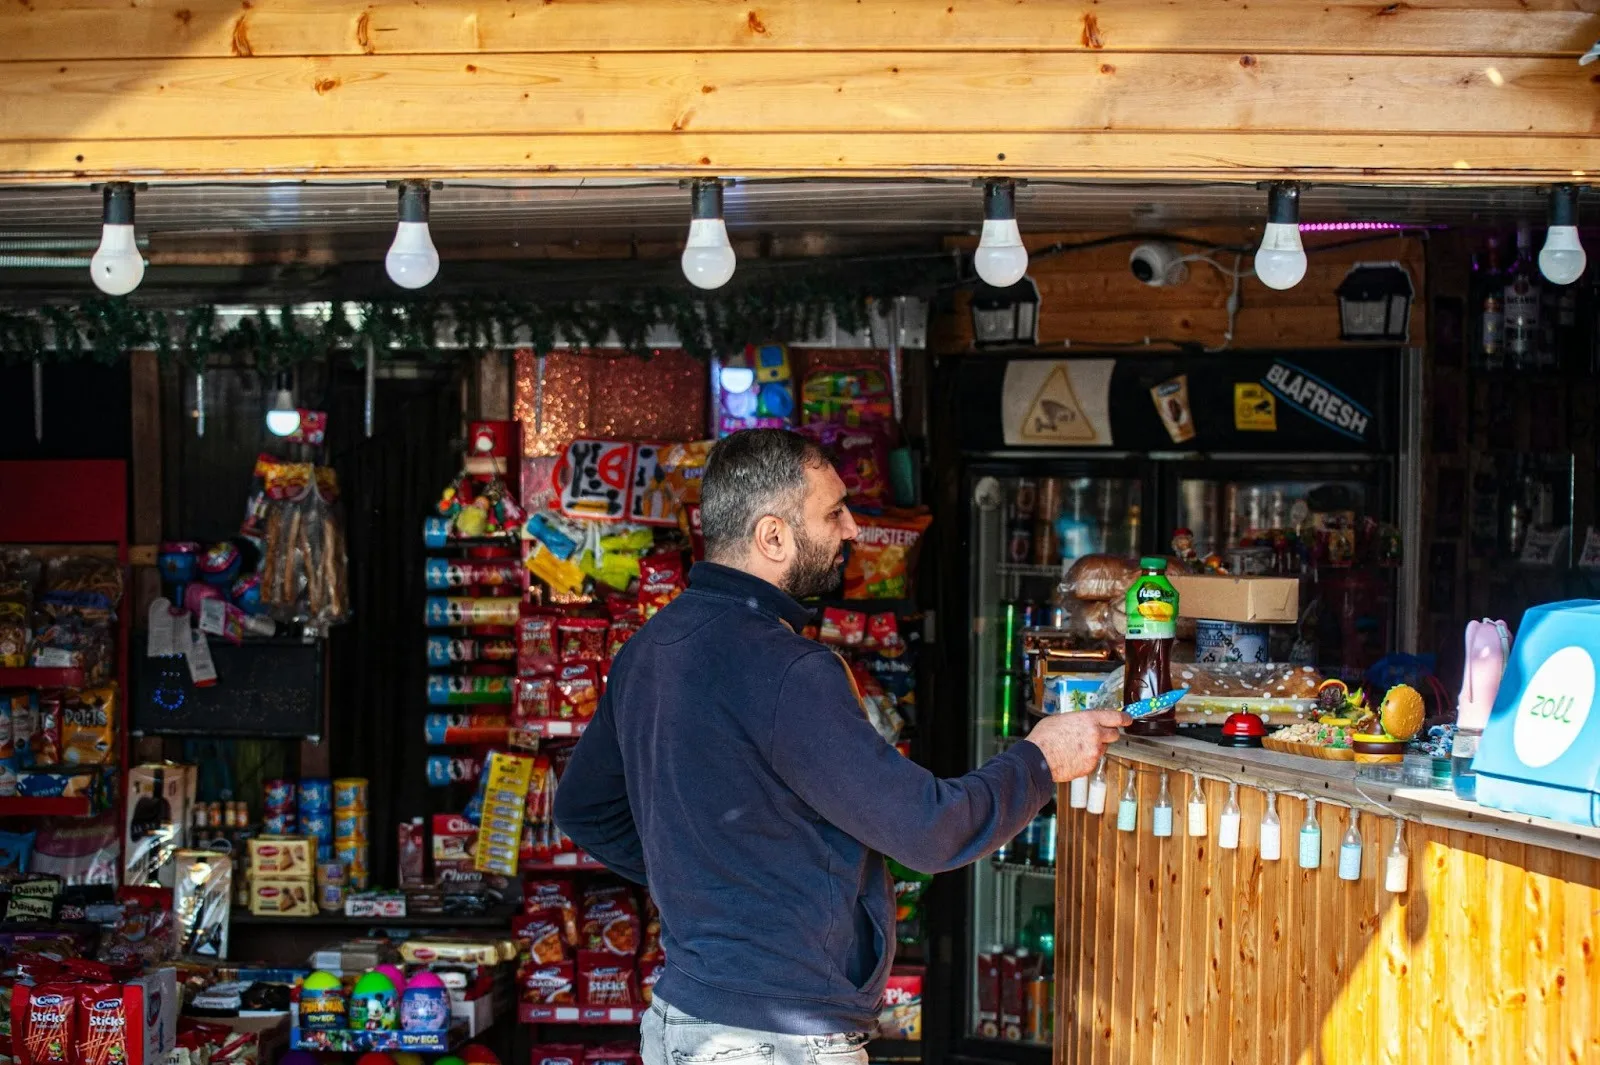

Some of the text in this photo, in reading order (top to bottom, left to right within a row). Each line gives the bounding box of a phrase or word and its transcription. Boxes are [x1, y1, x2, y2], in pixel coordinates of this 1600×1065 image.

[1265, 363, 1369, 434] BLAFRESH
[1139, 588, 1161, 598] fuse
[440, 868, 483, 883] Choco
[14, 885, 54, 895] Dankek
[10, 900, 49, 914] Dankek
[36, 995, 62, 1006] Croco
[95, 1000, 121, 1011] Croco
[31, 1012, 66, 1023] Sticks
[90, 1016, 125, 1027] Sticks
[403, 1034, 439, 1044] TOY EGG
